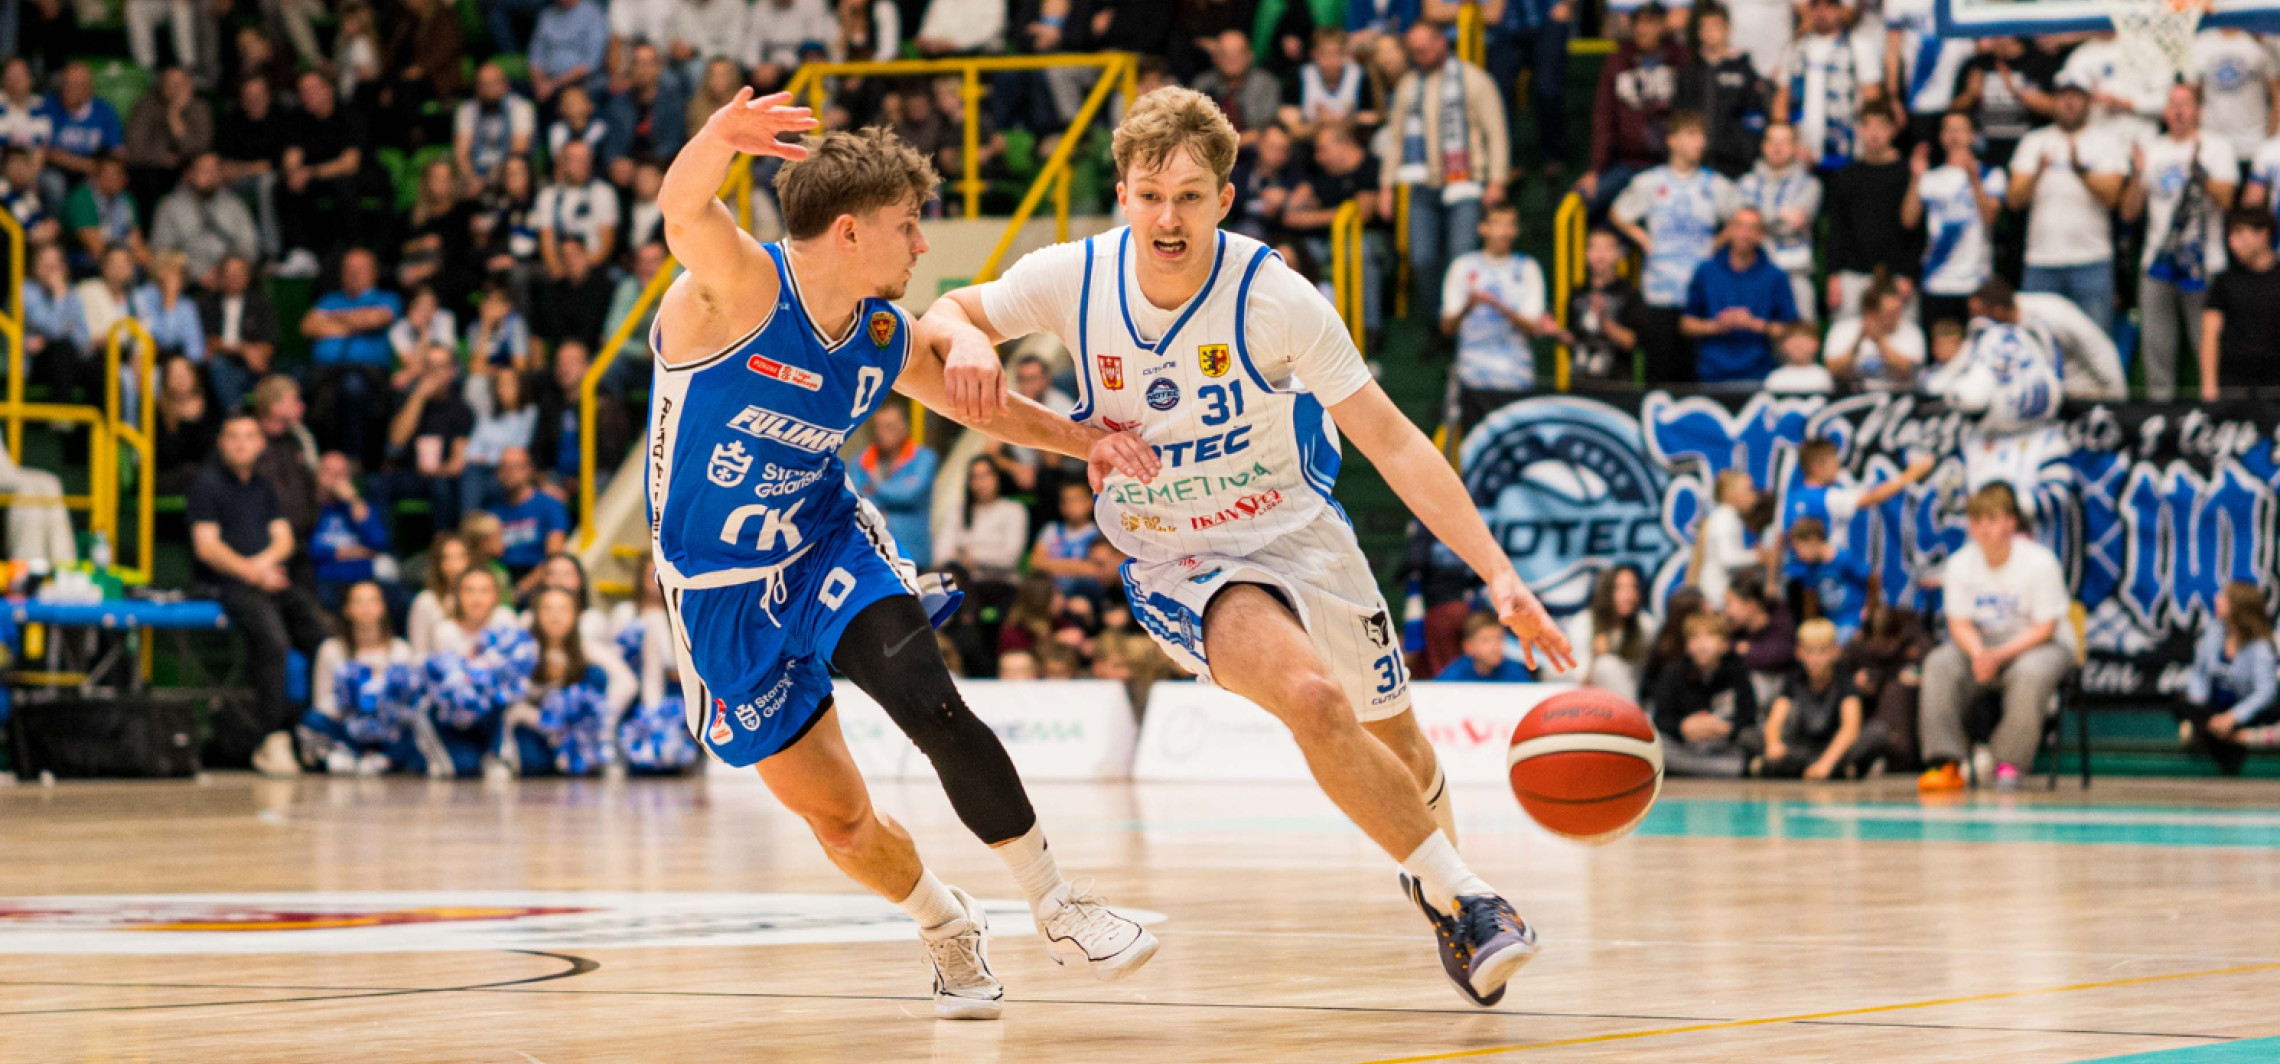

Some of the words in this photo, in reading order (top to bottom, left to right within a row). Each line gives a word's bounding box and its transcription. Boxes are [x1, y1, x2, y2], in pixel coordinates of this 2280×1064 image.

[851, 366, 883, 418] 0
[1198, 379, 1244, 426] 31
[1152, 425, 1253, 468] TEC
[818, 567, 858, 612] 0
[1373, 647, 1404, 694] 31
